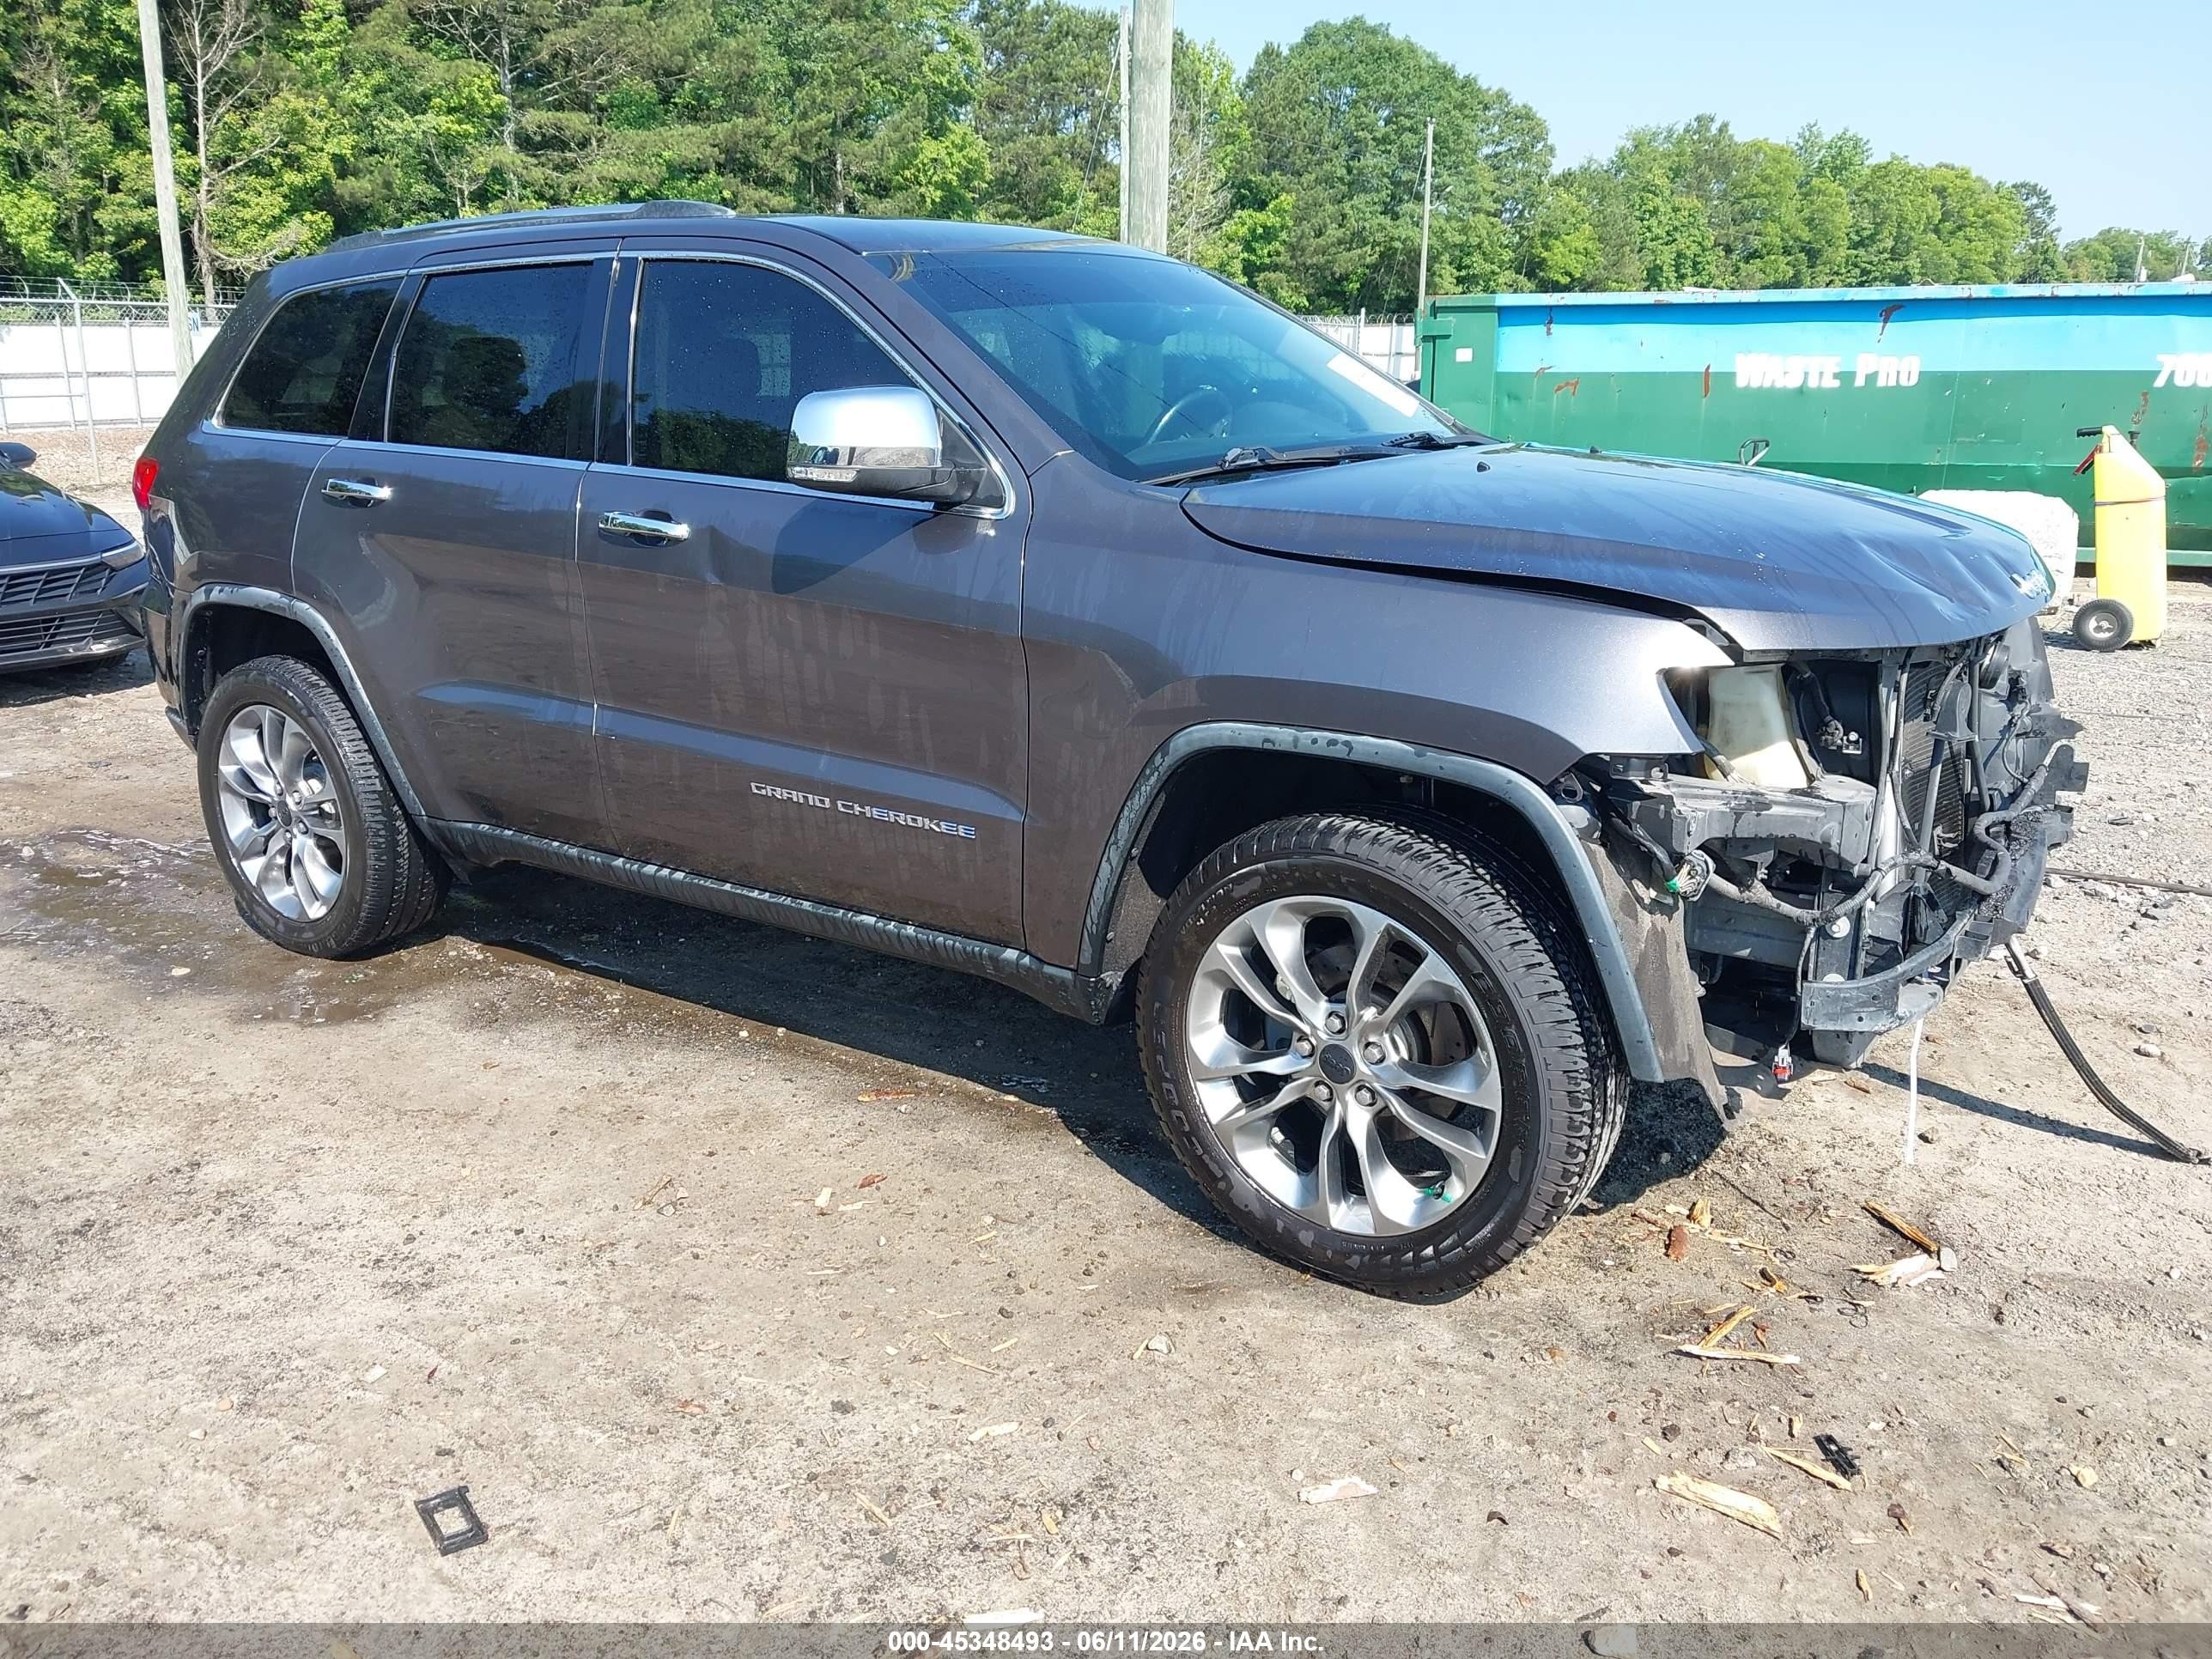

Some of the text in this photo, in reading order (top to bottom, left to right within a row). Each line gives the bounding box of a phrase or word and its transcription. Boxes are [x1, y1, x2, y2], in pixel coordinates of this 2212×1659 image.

[1735, 352, 1921, 388] WASTE PRO
[750, 781, 976, 839] GRAND CHEROKEE
